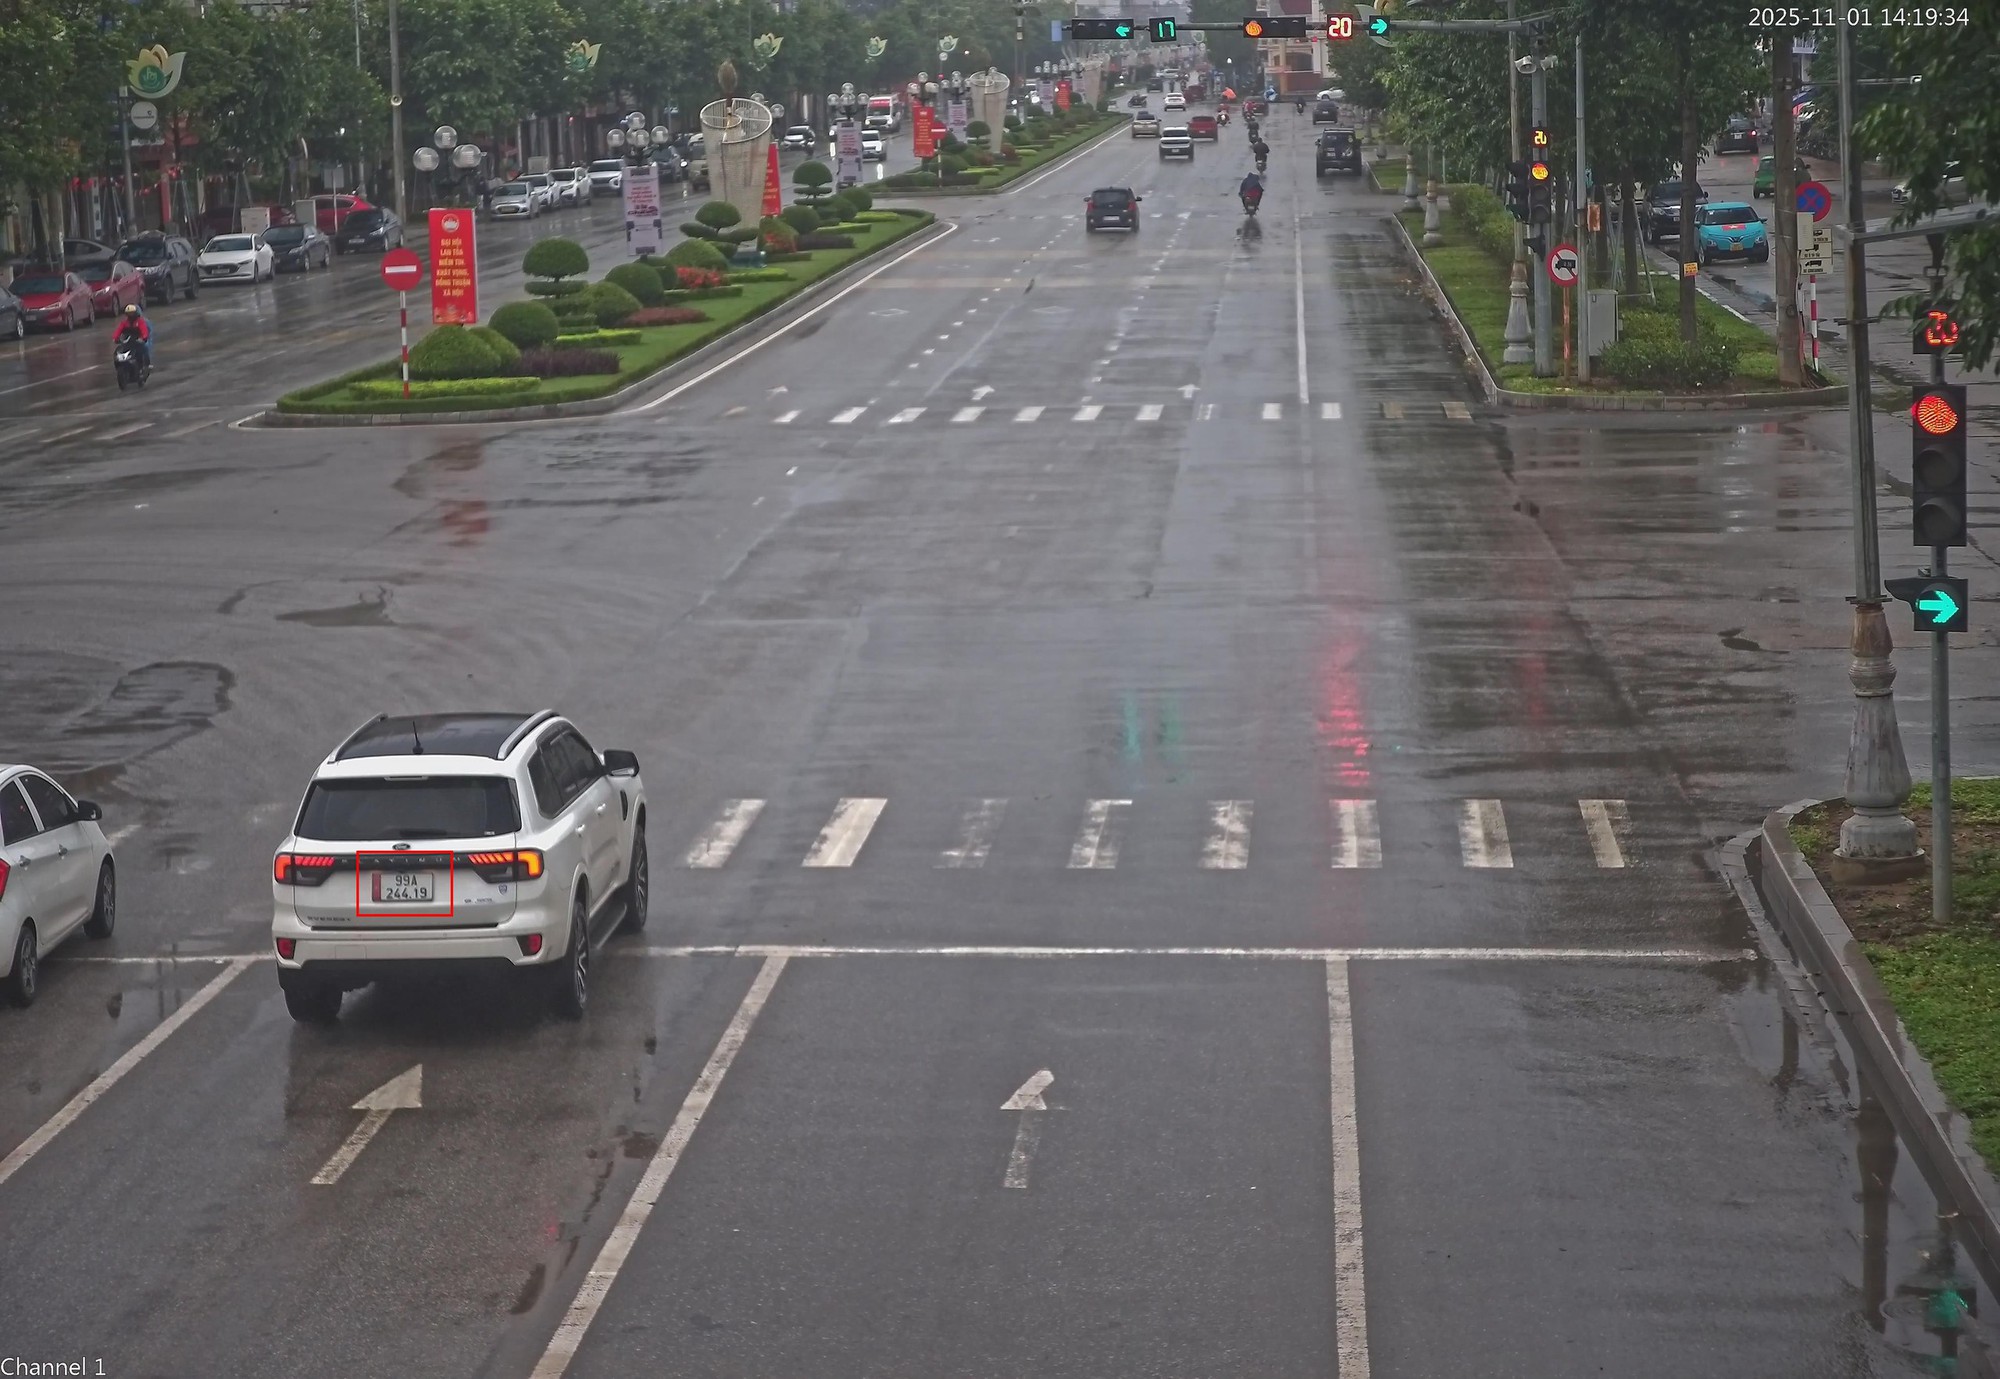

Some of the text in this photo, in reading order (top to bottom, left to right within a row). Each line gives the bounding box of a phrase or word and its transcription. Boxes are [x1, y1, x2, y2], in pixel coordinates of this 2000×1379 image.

[1158, 20, 1176, 38] 17
[1328, 17, 1352, 37] 20
[395, 875, 418, 887] 99A
[386, 887, 428, 899] 244.19
